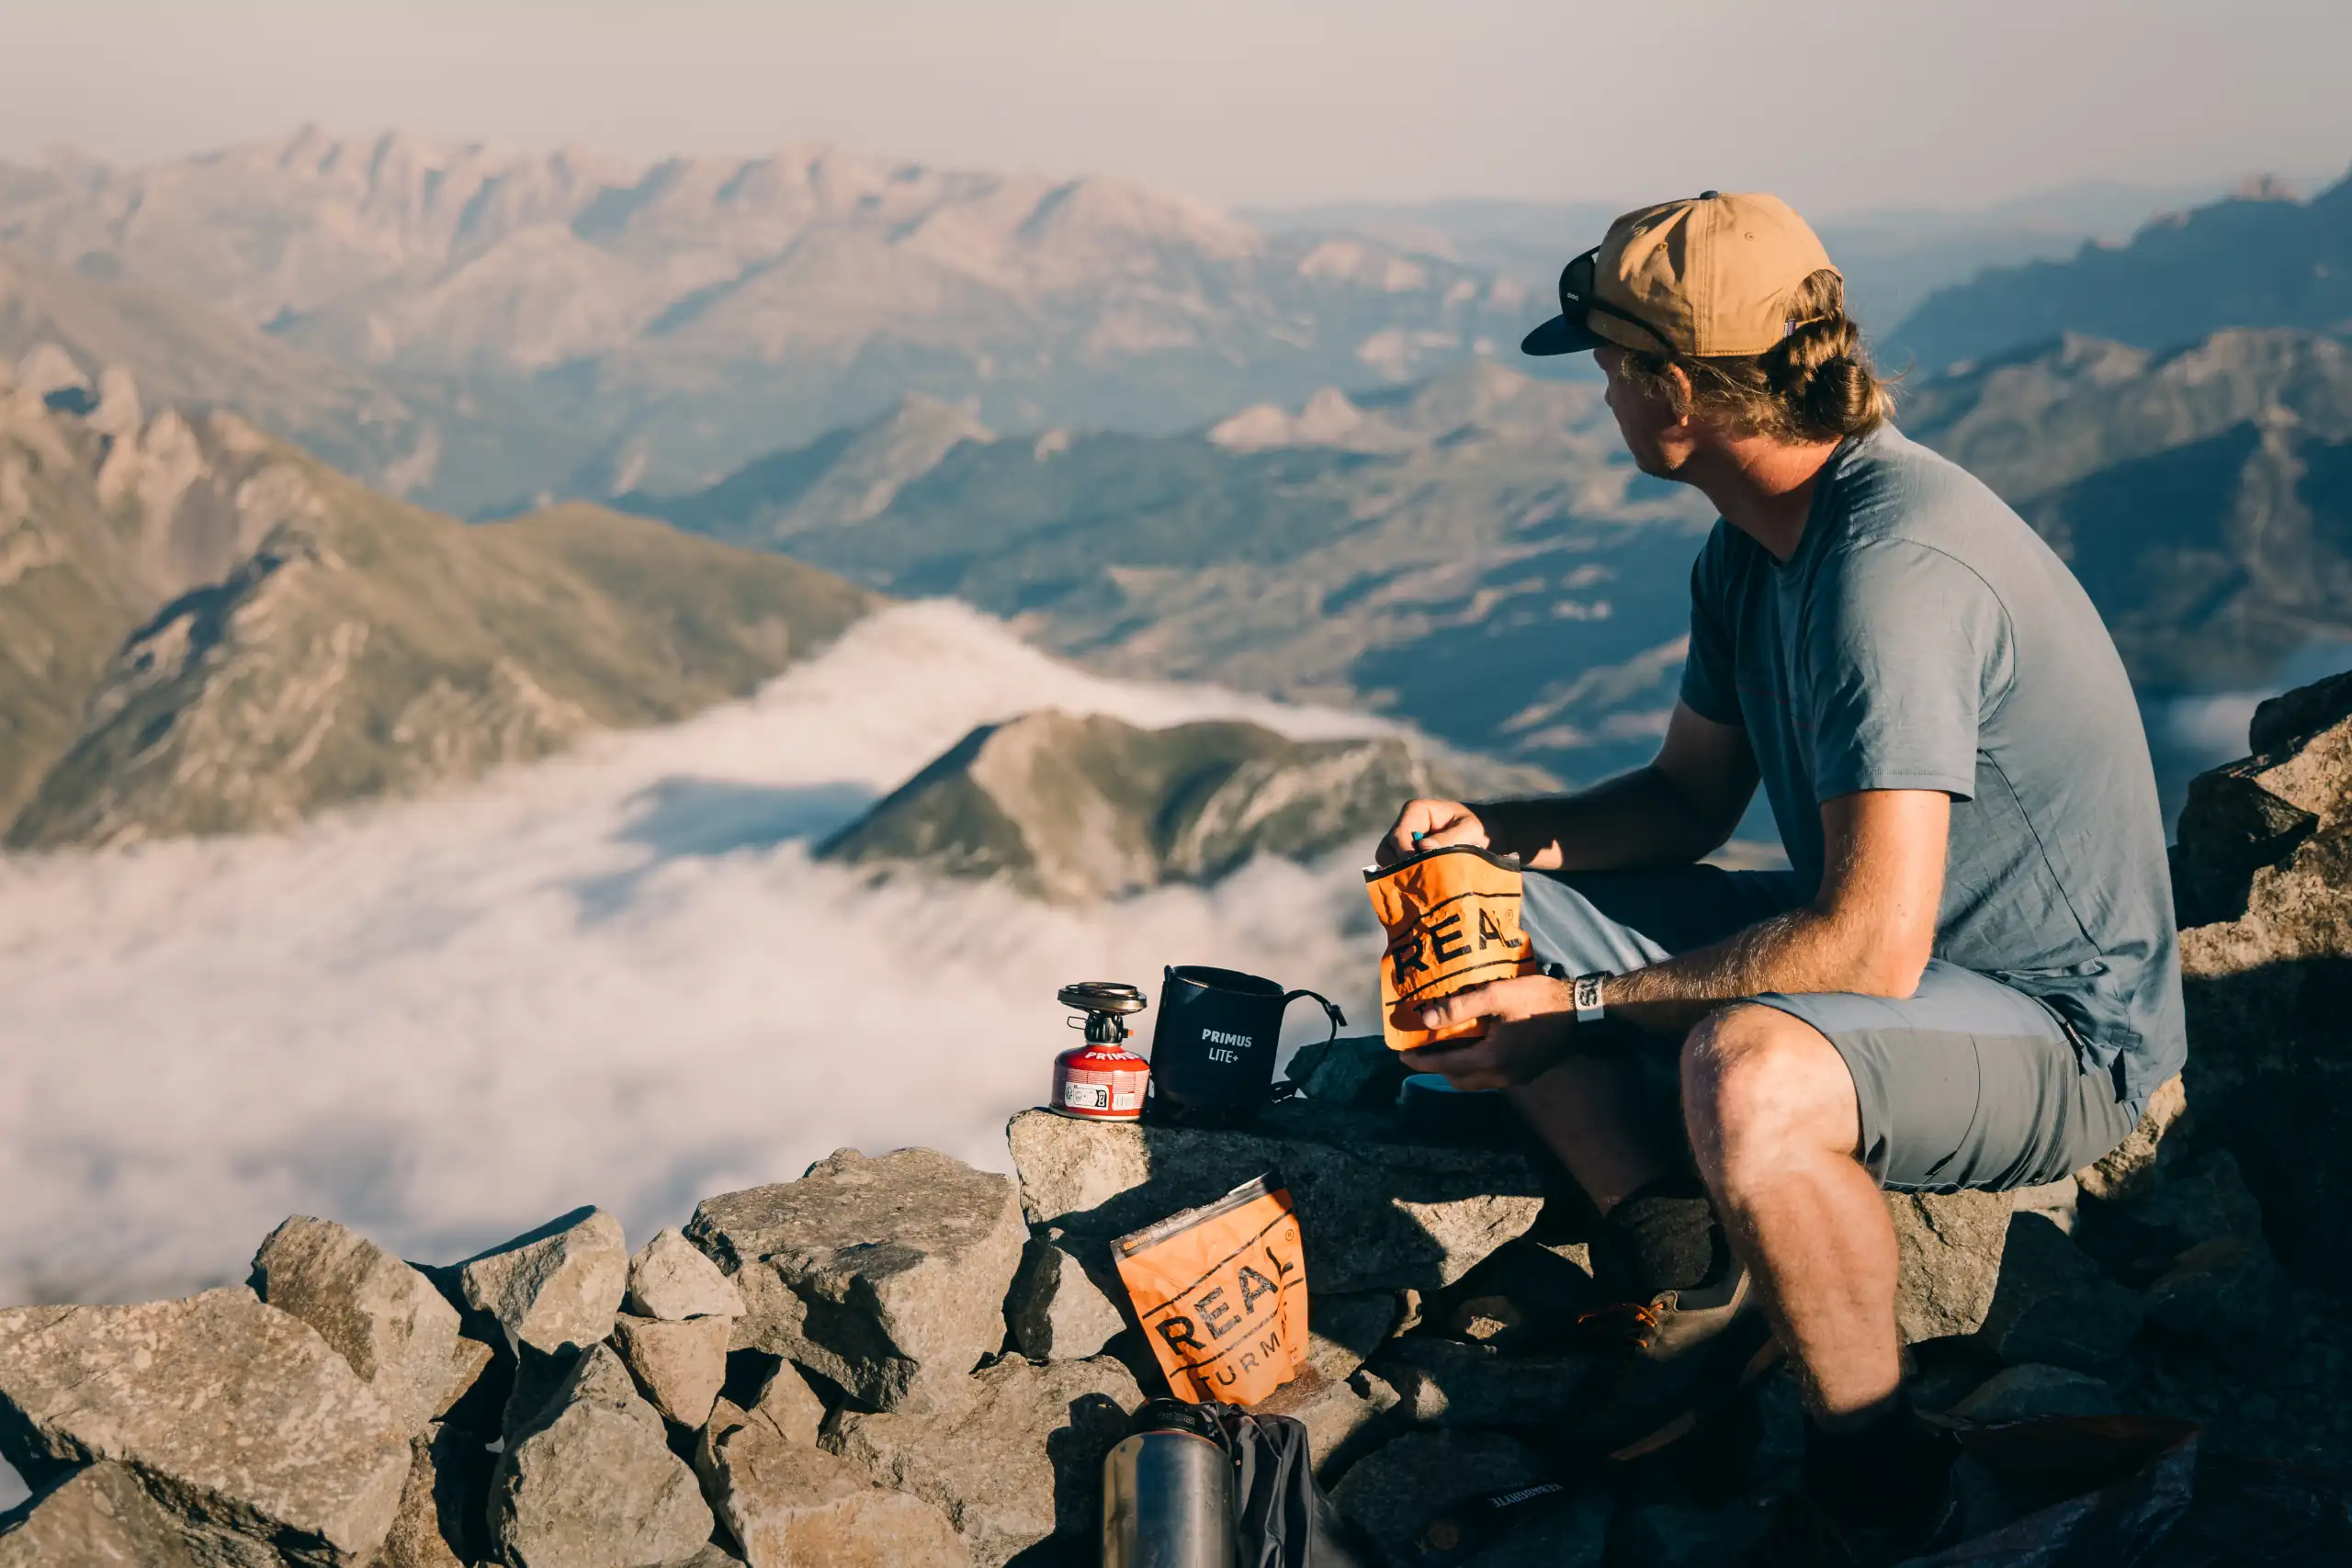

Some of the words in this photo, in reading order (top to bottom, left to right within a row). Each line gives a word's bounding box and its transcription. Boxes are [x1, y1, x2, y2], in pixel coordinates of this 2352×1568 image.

[1202, 1028, 1252, 1047] PRIMUS
[1208, 1047, 1238, 1063] LITE+
[1155, 1246, 1295, 1356] REAL
